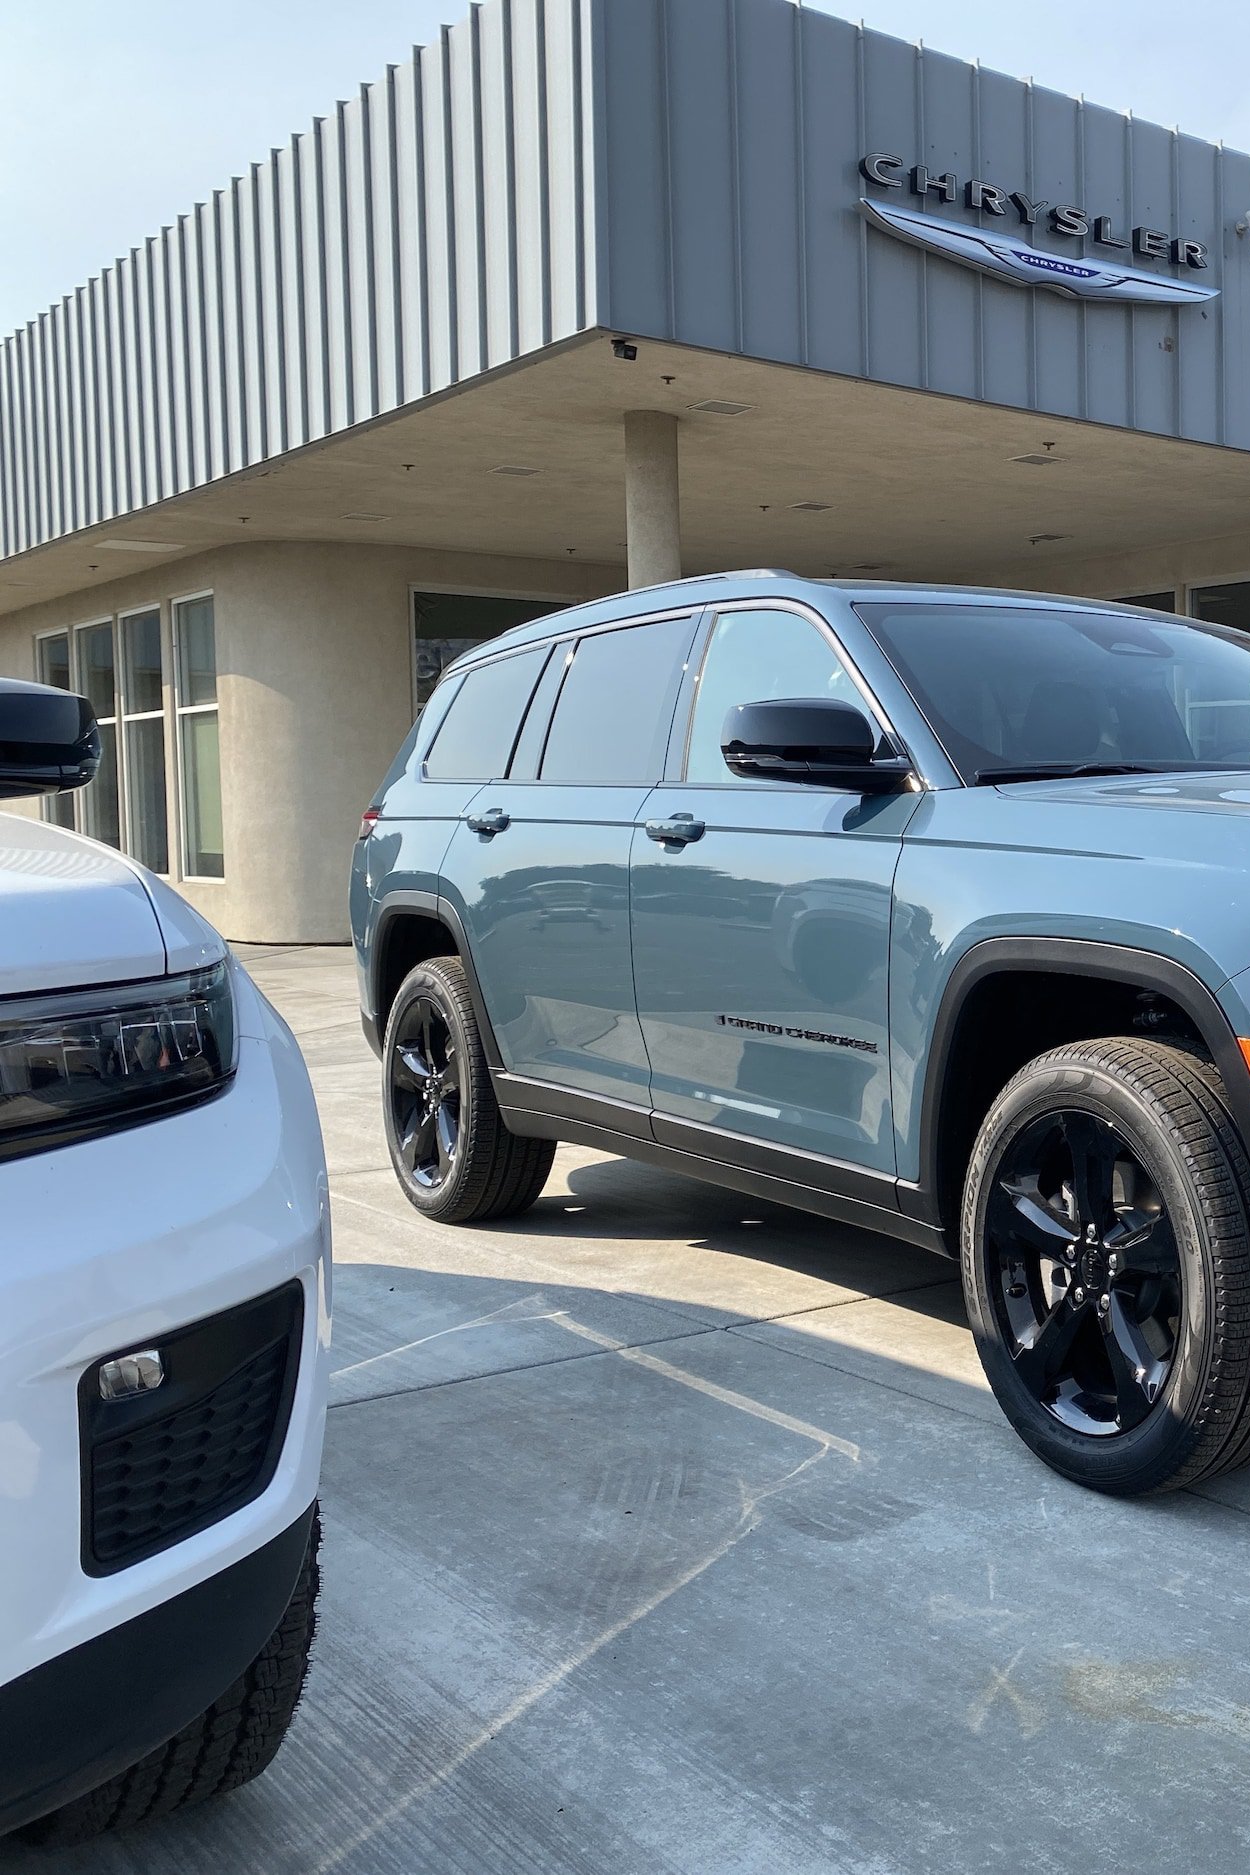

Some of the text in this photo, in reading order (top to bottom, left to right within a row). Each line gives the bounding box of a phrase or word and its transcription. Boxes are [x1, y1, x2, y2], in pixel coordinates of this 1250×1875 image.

[860, 152, 1209, 269] CHRYSLER
[1020, 255, 1090, 277] CHRYSLER
[727, 1014, 878, 1054] GRAND CHEROKEE
